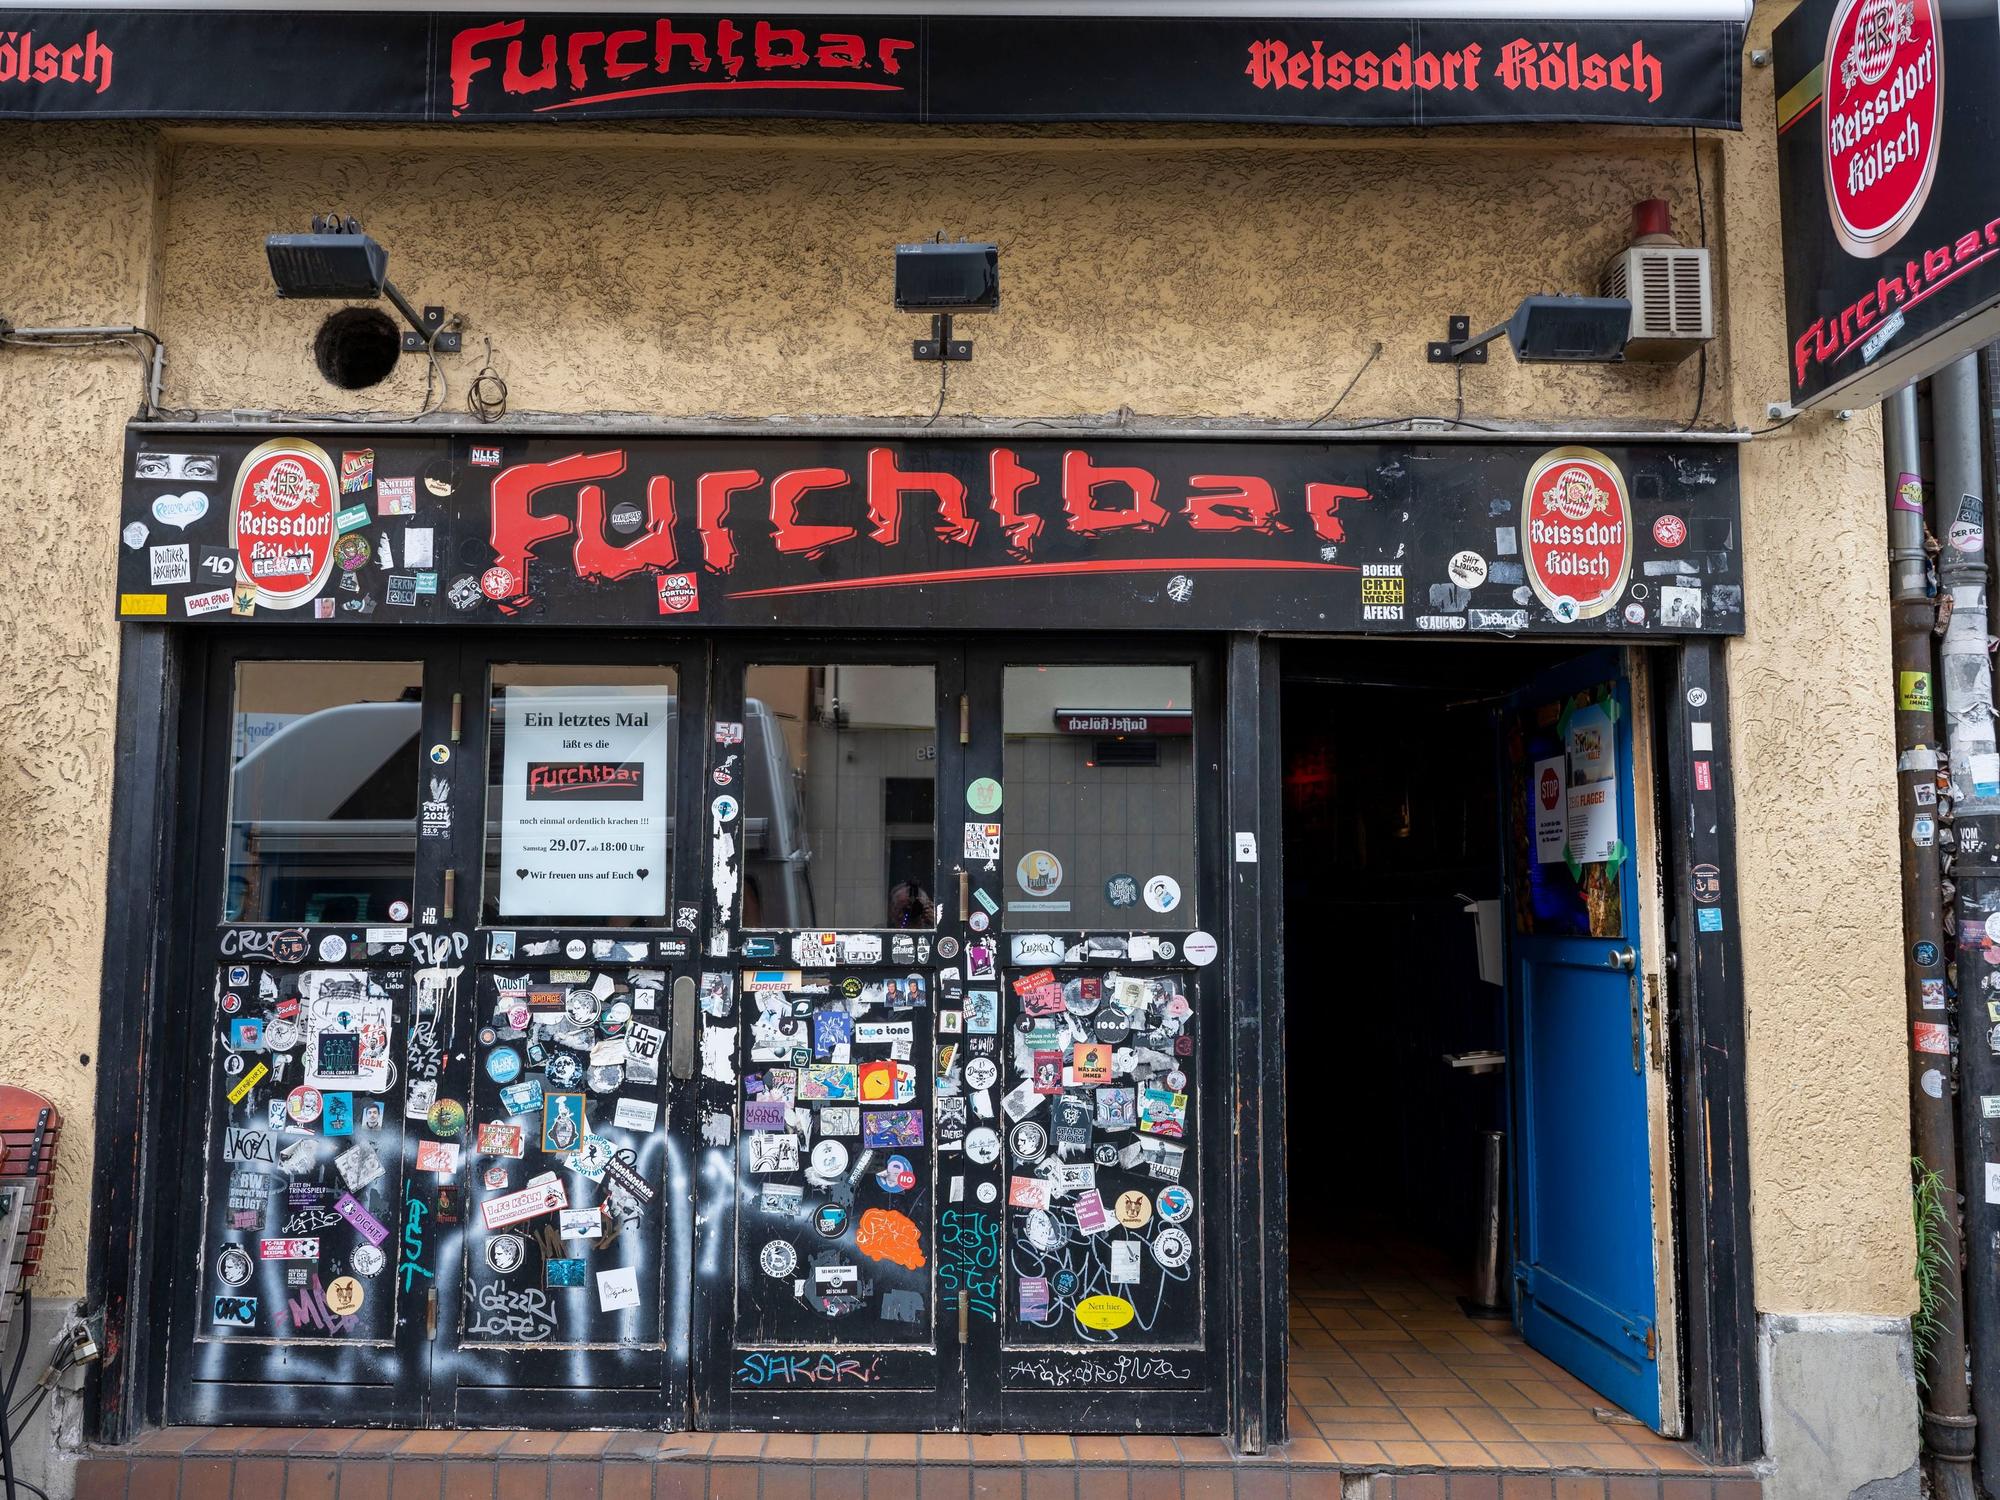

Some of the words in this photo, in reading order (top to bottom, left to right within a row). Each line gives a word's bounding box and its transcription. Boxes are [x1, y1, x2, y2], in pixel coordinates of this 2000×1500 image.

[451, 17, 915, 118] Furchtbar
[1245, 38, 1483, 92] Reissdorf
[1494, 38, 1664, 104] Kölsch
[1830, 38, 1934, 158] Reissdorf
[1846, 112, 1922, 198] Kölsch
[240, 510, 331, 537] Reissdorf
[489, 448, 1374, 617] Furchtbar
[1532, 519, 1623, 546] Reissdorf
[1951, 529, 1968, 538] DER
[1362, 564, 1403, 577] BOEREK
[1545, 551, 1610, 581] Kölsch
[1363, 579, 1403, 591] CRTN
[661, 588, 695, 598] FORTUNA
[1363, 595, 1403, 603] MOSH
[1363, 606, 1404, 620] AFEKS1
[524, 713, 554, 727] Ein
[558, 712, 611, 727] letztes
[615, 712, 649, 727] Mal
[562, 740, 582, 750] läßt
[595, 740, 610, 749] die
[530, 764, 641, 795] Furchtbar
[1541, 780, 1560, 799] STOP
[1580, 791, 1605, 807] FLAGGE!
[519, 817, 539, 825] noch
[539, 817, 566, 825] einmal
[567, 817, 606, 825] ordentlich
[607, 817, 639, 825] krachen
[1960, 828, 1978, 839] VOM
[523, 845, 547, 853] Samstag
[549, 838, 591, 852] 29.07.
[599, 841, 628, 852] 18:00
[629, 844, 645, 852] Uhr
[530, 871, 547, 880] Wir
[548, 870, 577, 880] freuen
[595, 870, 611, 880] auf
[612, 871, 634, 880] Euch
[659, 941, 686, 951] Nilles
[749, 983, 793, 991] FORVERT
[858, 1026, 883, 1036] tape
[886, 1026, 910, 1035] tone
[520, 1101, 541, 1111] Future
[487, 1200, 511, 1216] 1.FC
[511, 1191, 543, 1211] KÖLN
[355, 1213, 383, 1241] DICHT!
[1088, 1303, 1105, 1311] Nett
